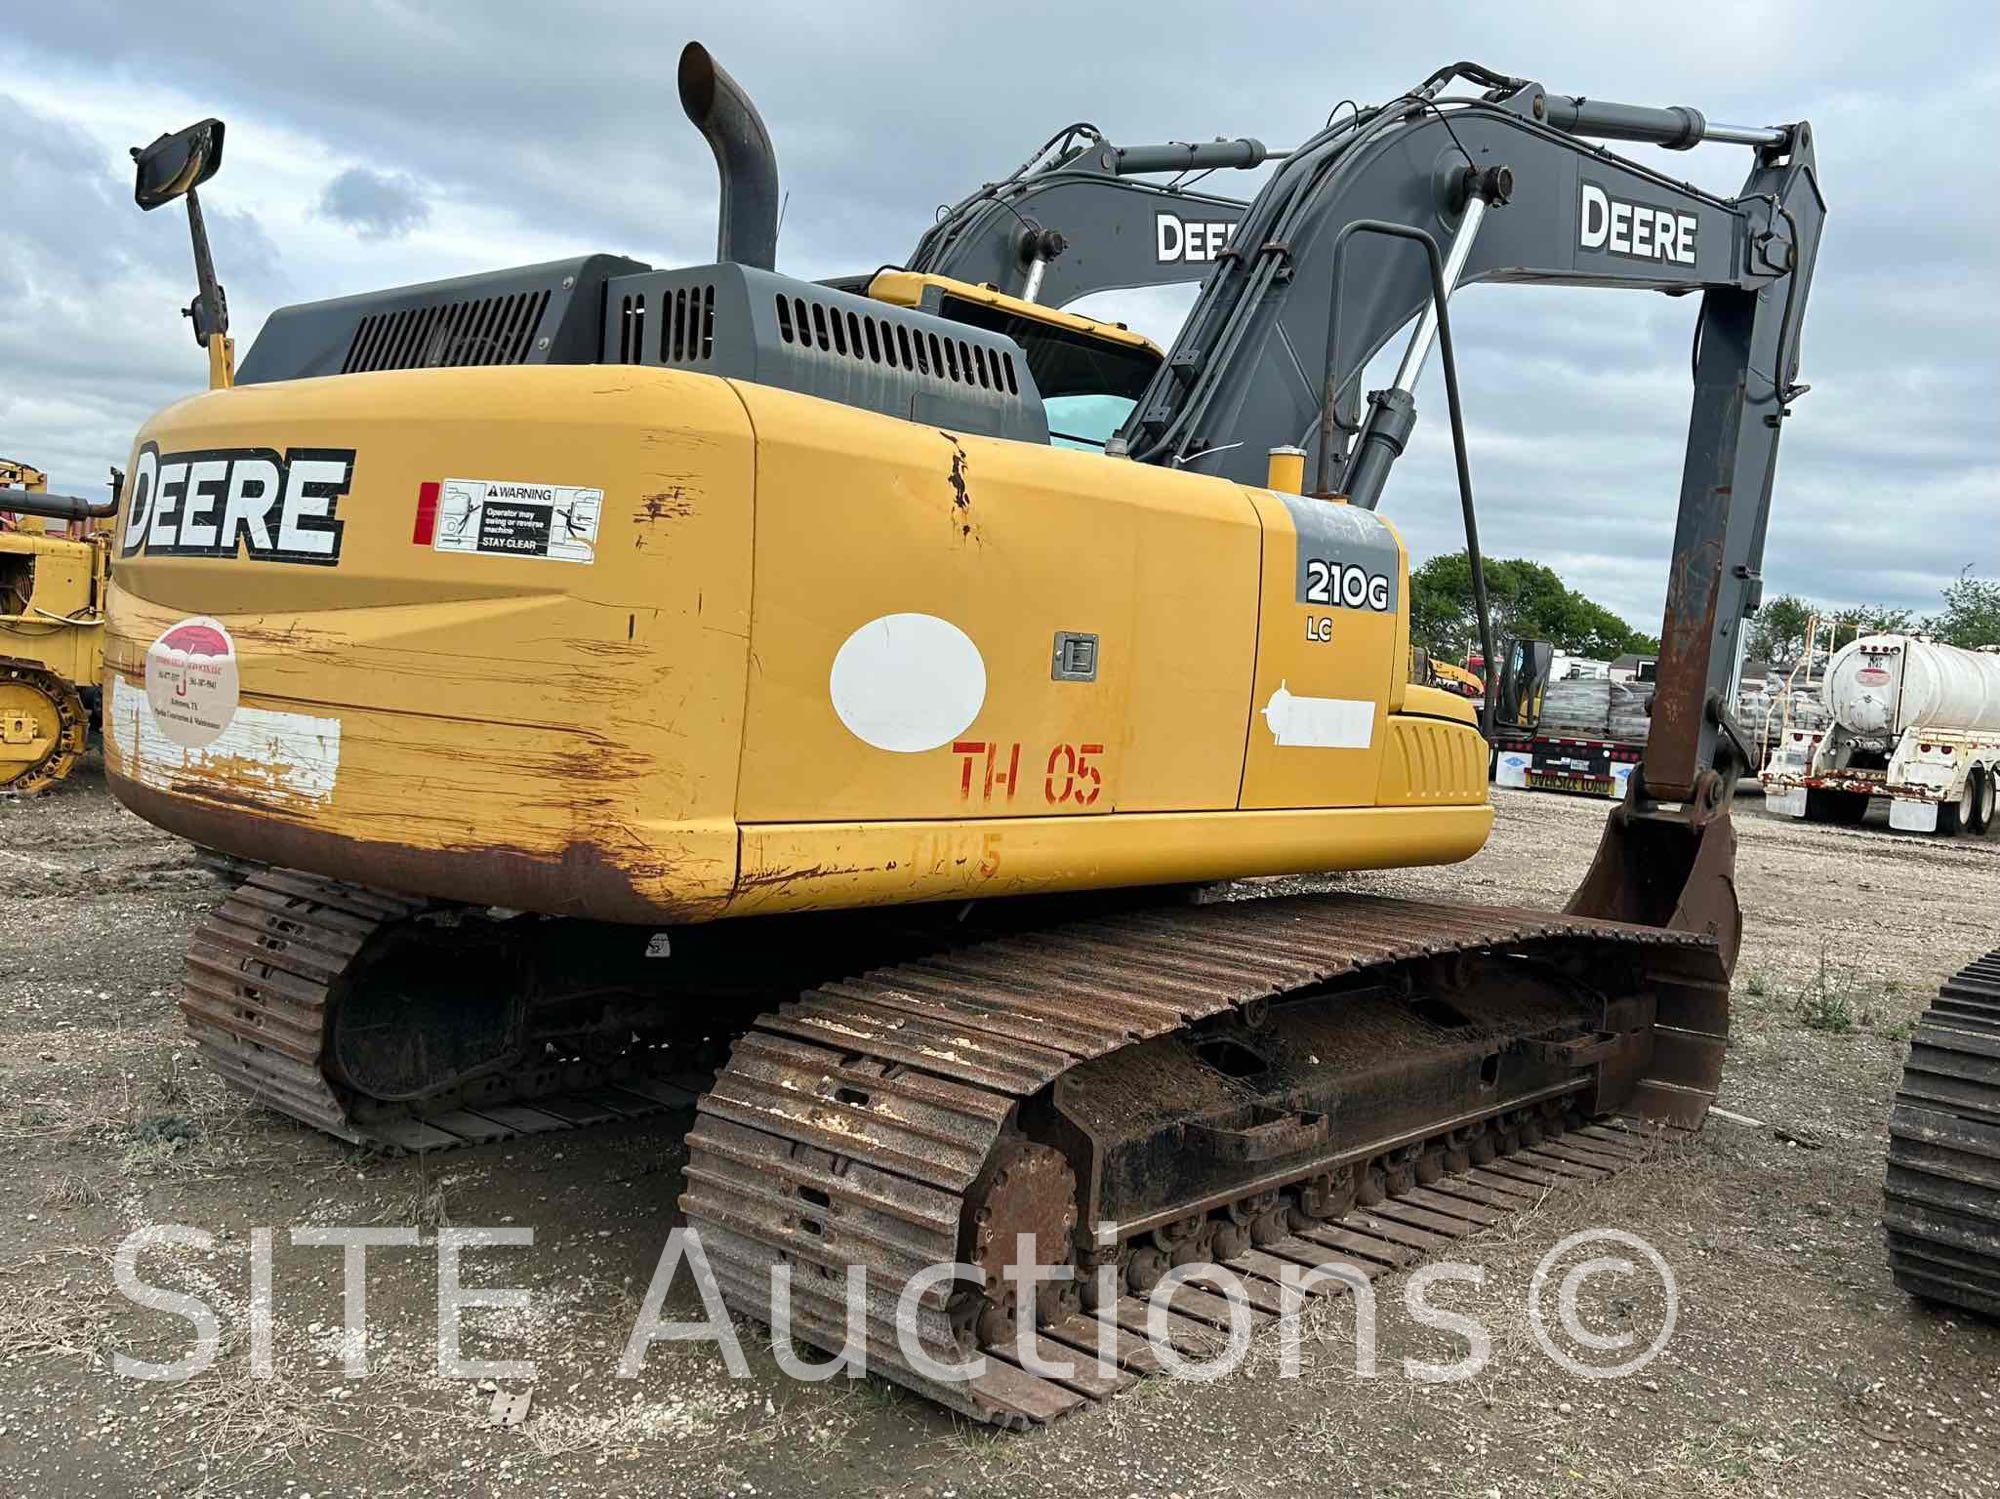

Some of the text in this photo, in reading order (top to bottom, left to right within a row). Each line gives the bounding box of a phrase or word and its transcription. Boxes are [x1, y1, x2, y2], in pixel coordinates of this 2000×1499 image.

[1580, 184, 1697, 264] DEERE
[1157, 213, 1238, 261] DEE
[124, 448, 350, 556] DEERE
[499, 486, 552, 501] WARNING
[485, 508, 535, 519] Operator may
[485, 517, 545, 529] swing or reverse
[482, 537, 537, 550] STAY CLEAR
[1306, 561, 1389, 611] 210G
[1306, 617, 1332, 642] LC
[952, 741, 1105, 806] TH 05
[1529, 773, 1610, 793] OVERSIZE LOAD
